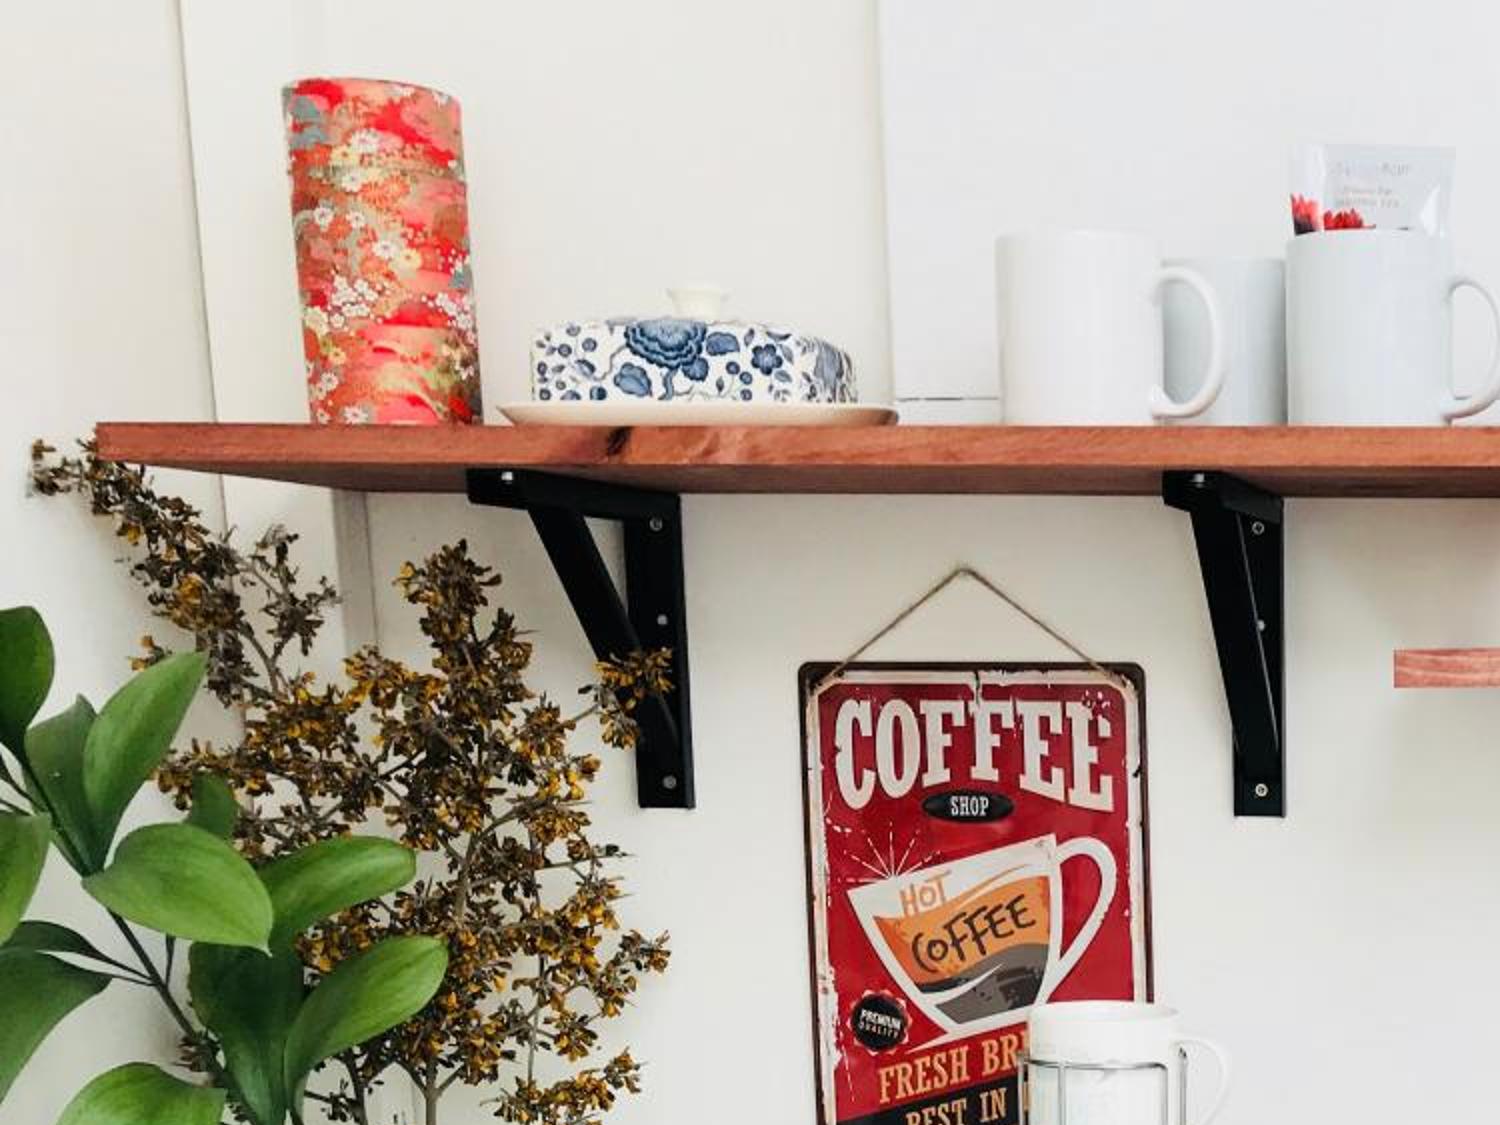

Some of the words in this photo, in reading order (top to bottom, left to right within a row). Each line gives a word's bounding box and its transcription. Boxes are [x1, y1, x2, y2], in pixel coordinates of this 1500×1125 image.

[836, 695, 1114, 813] COFFEE
[950, 795, 989, 816] SHOP
[900, 869, 953, 916] HOT
[878, 1045, 971, 1105] FRESH
[979, 1087, 1007, 1122] IN
